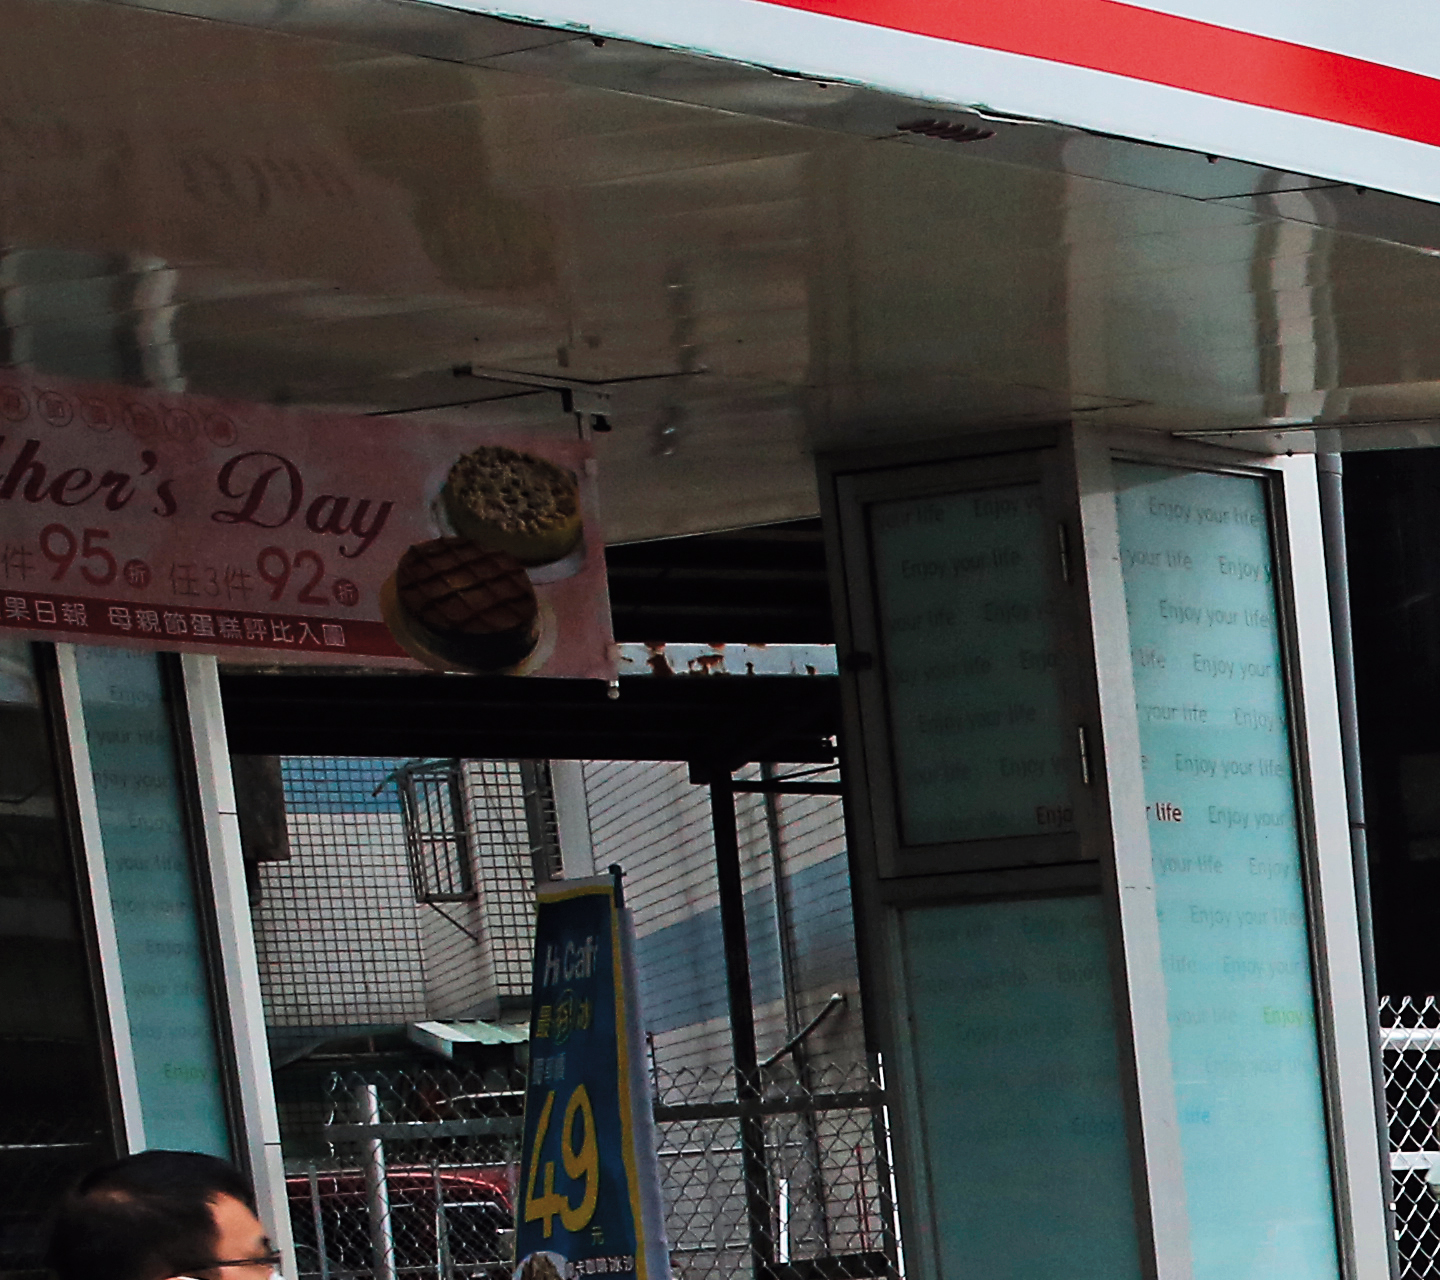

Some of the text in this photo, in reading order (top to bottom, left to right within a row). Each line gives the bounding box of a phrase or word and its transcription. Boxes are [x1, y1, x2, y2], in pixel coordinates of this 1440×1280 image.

[0, 435, 396, 559] her's Day
[1155, 802, 1183, 823] life
[524, 1083, 599, 1239] 49
